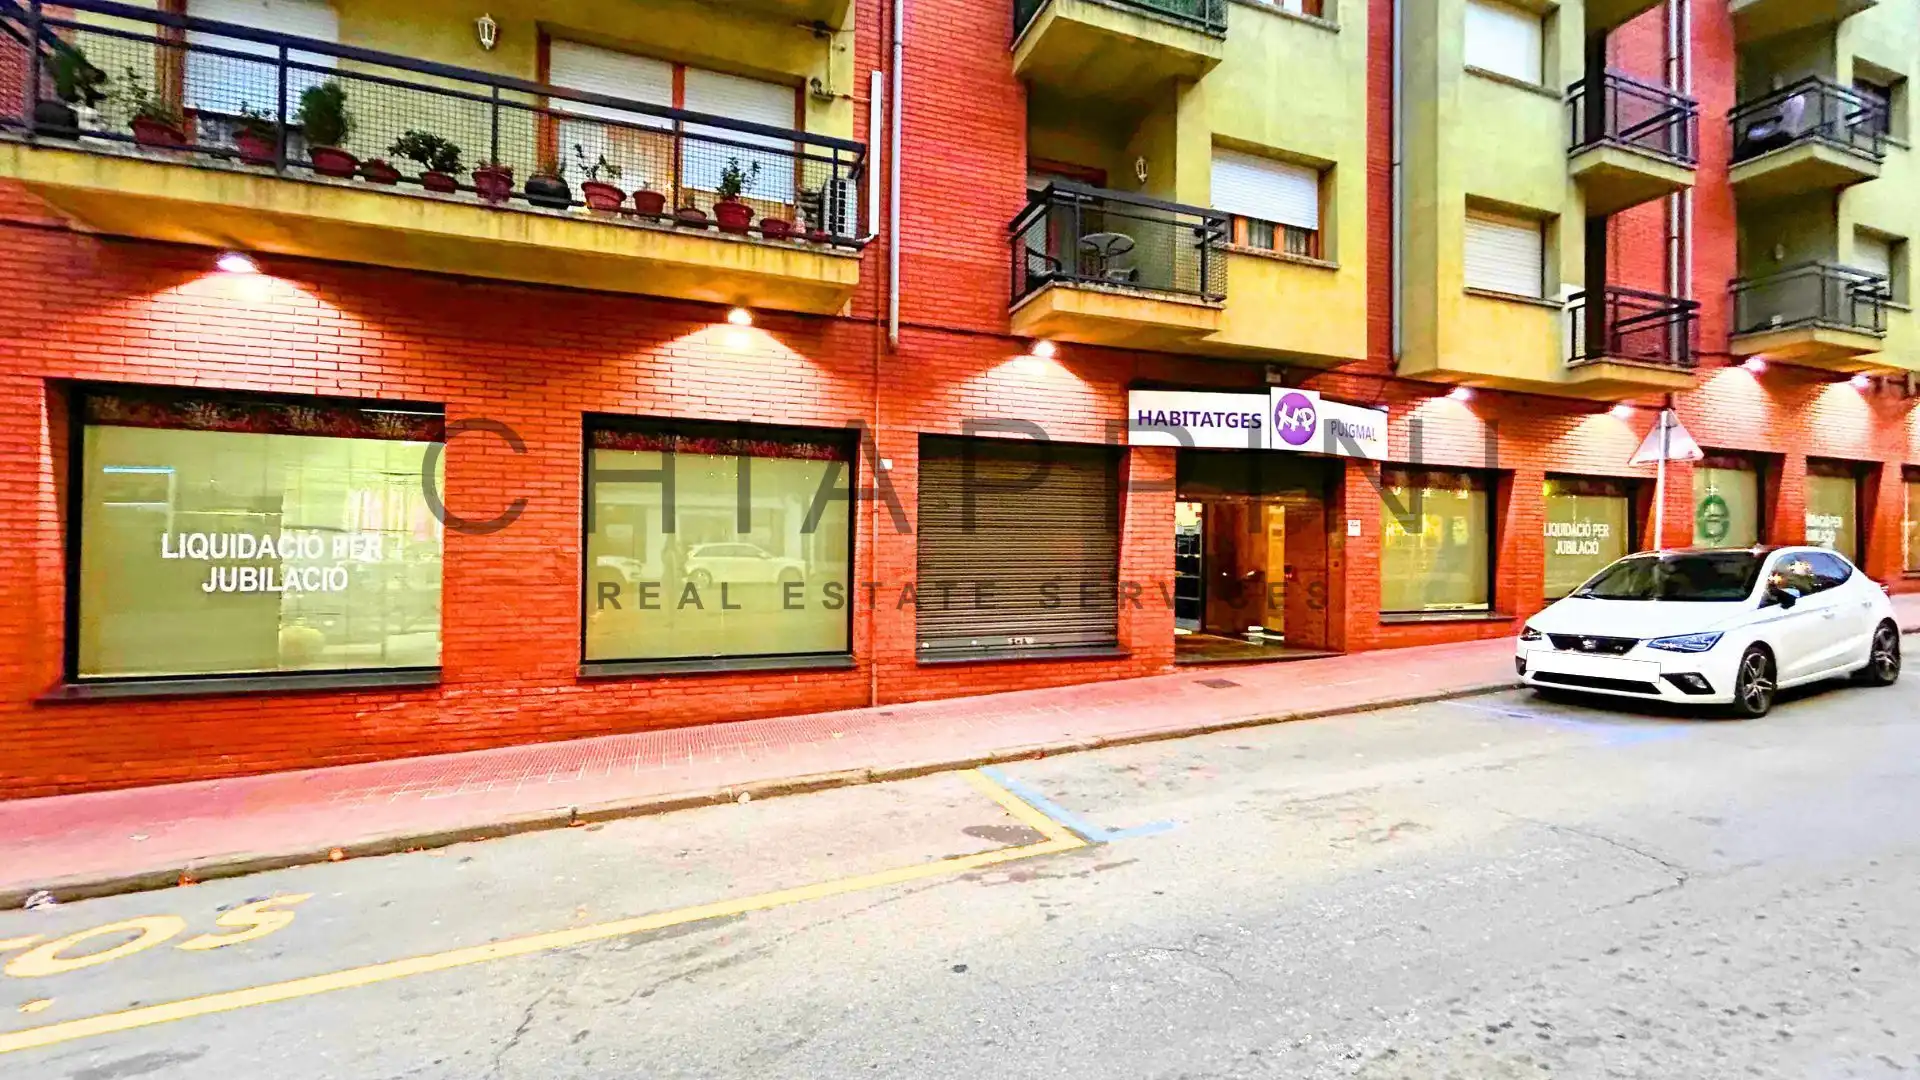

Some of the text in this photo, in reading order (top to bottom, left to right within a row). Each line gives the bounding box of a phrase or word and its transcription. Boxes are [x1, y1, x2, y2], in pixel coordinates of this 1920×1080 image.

[1137, 409, 1262, 429] HABITATGES
[1330, 419, 1377, 442] PUIGMAL
[1592, 524, 1609, 537] PER
[161, 529, 383, 561] LIQUIDACIÓ PER
[201, 560, 348, 592] JUBILACIÓ
[0, 892, 314, 977] OS
